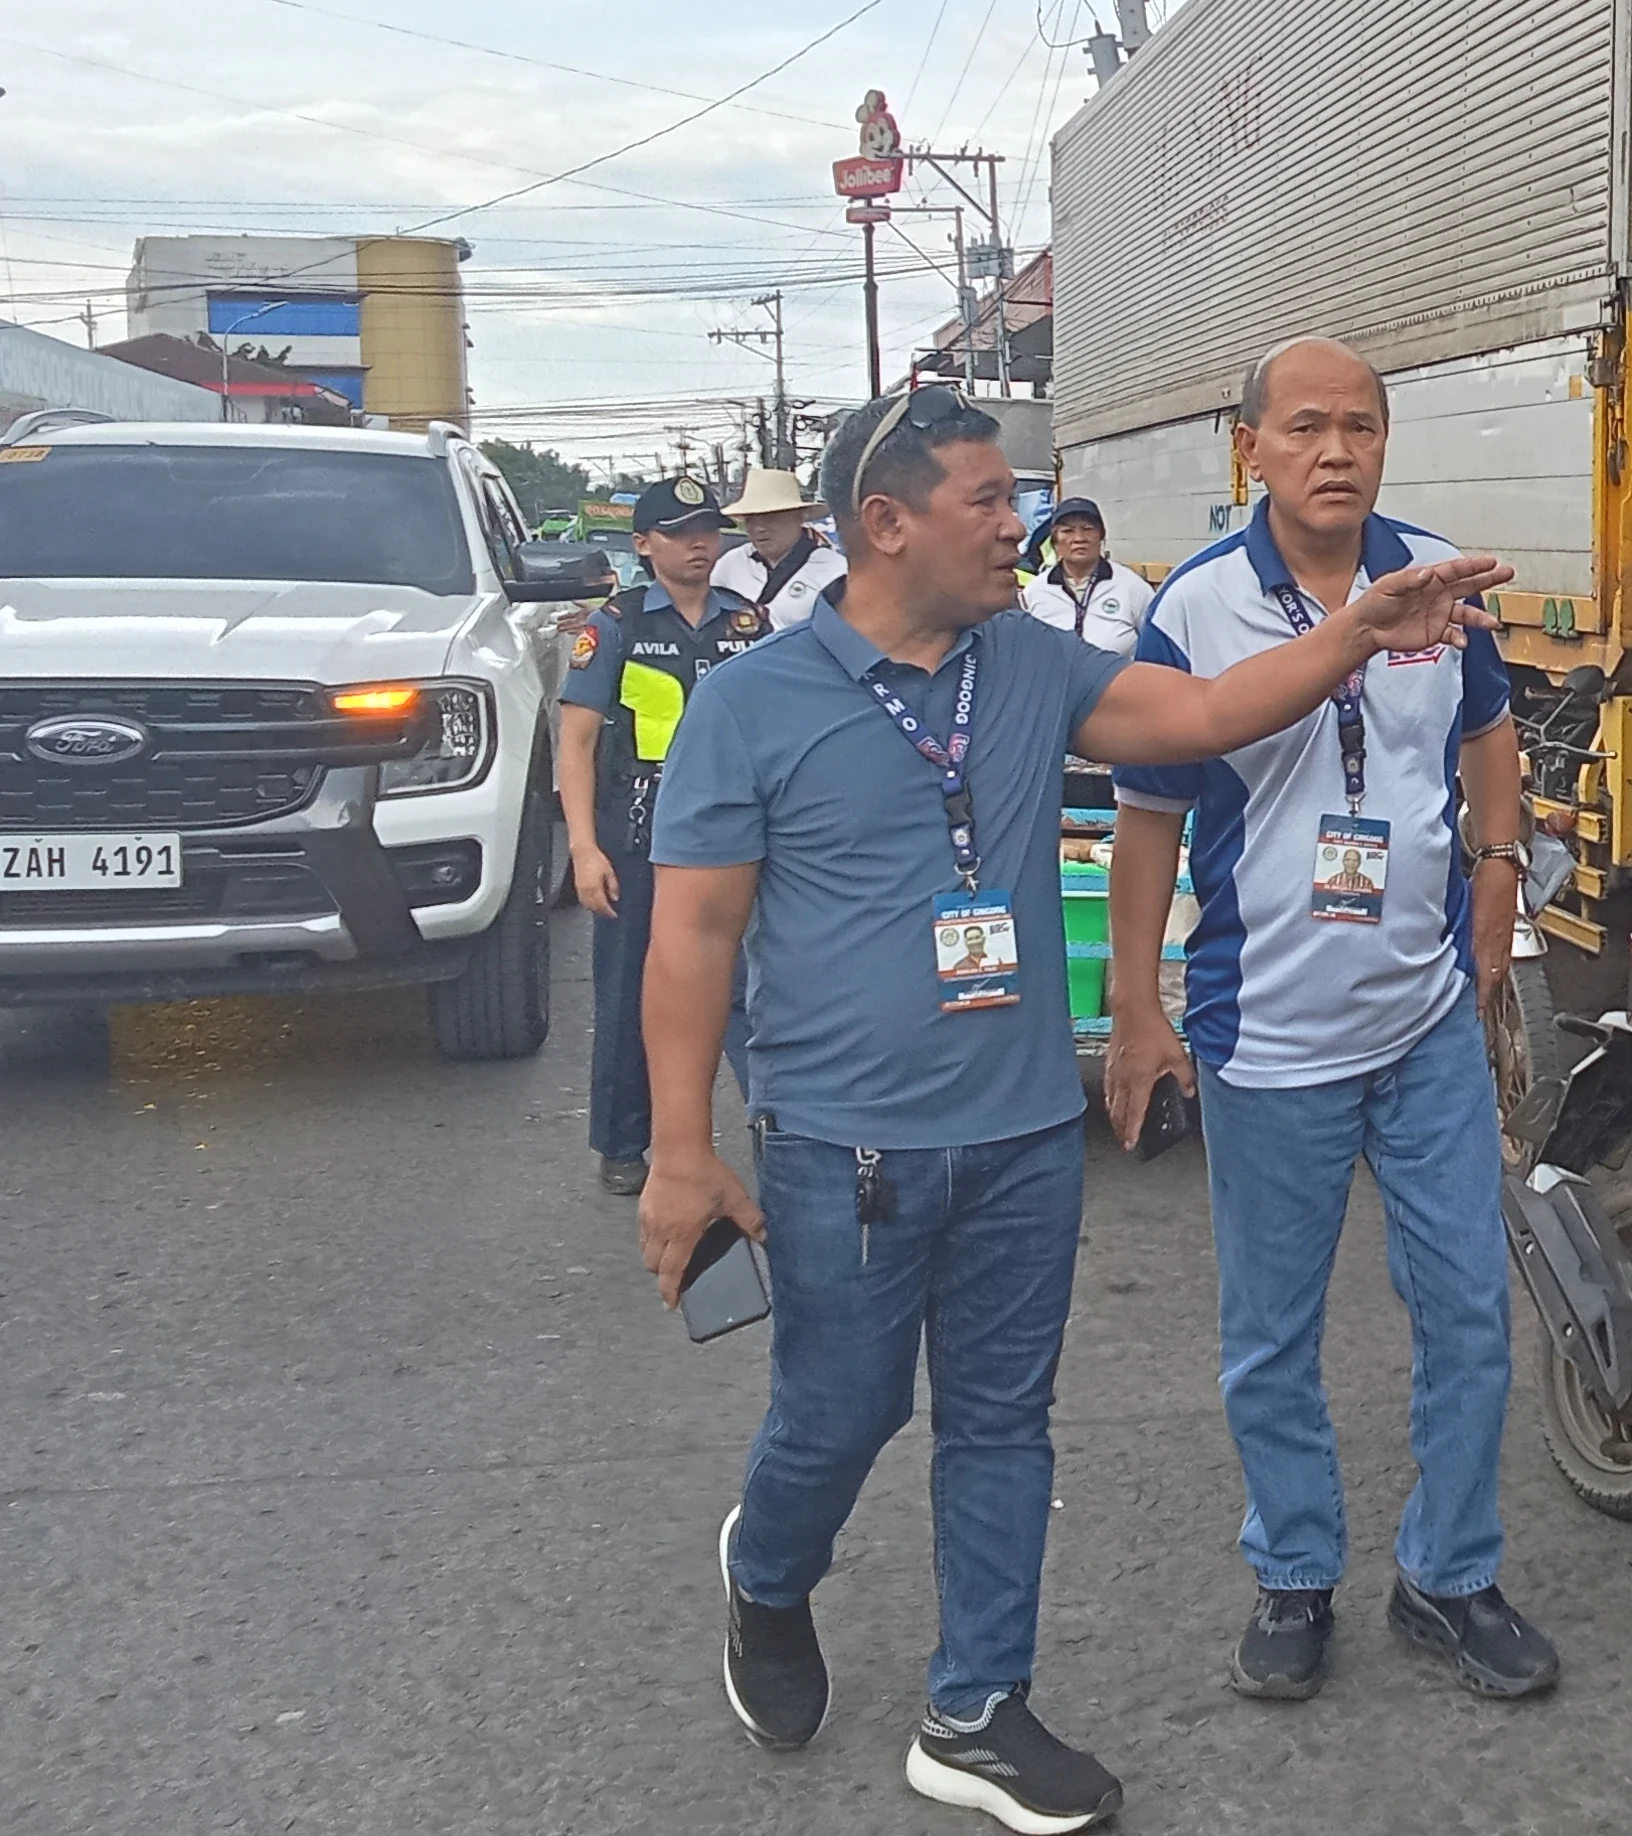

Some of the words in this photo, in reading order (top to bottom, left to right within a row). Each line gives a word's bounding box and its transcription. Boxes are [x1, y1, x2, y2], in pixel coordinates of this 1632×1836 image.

[840, 165, 892, 189] Jollibee
[1209, 504, 1232, 532] NOT
[632, 641, 679, 655] AVILA
[55, 730, 117, 752] Ford
[3, 847, 65, 878] ZAH
[92, 845, 175, 876] 4191
